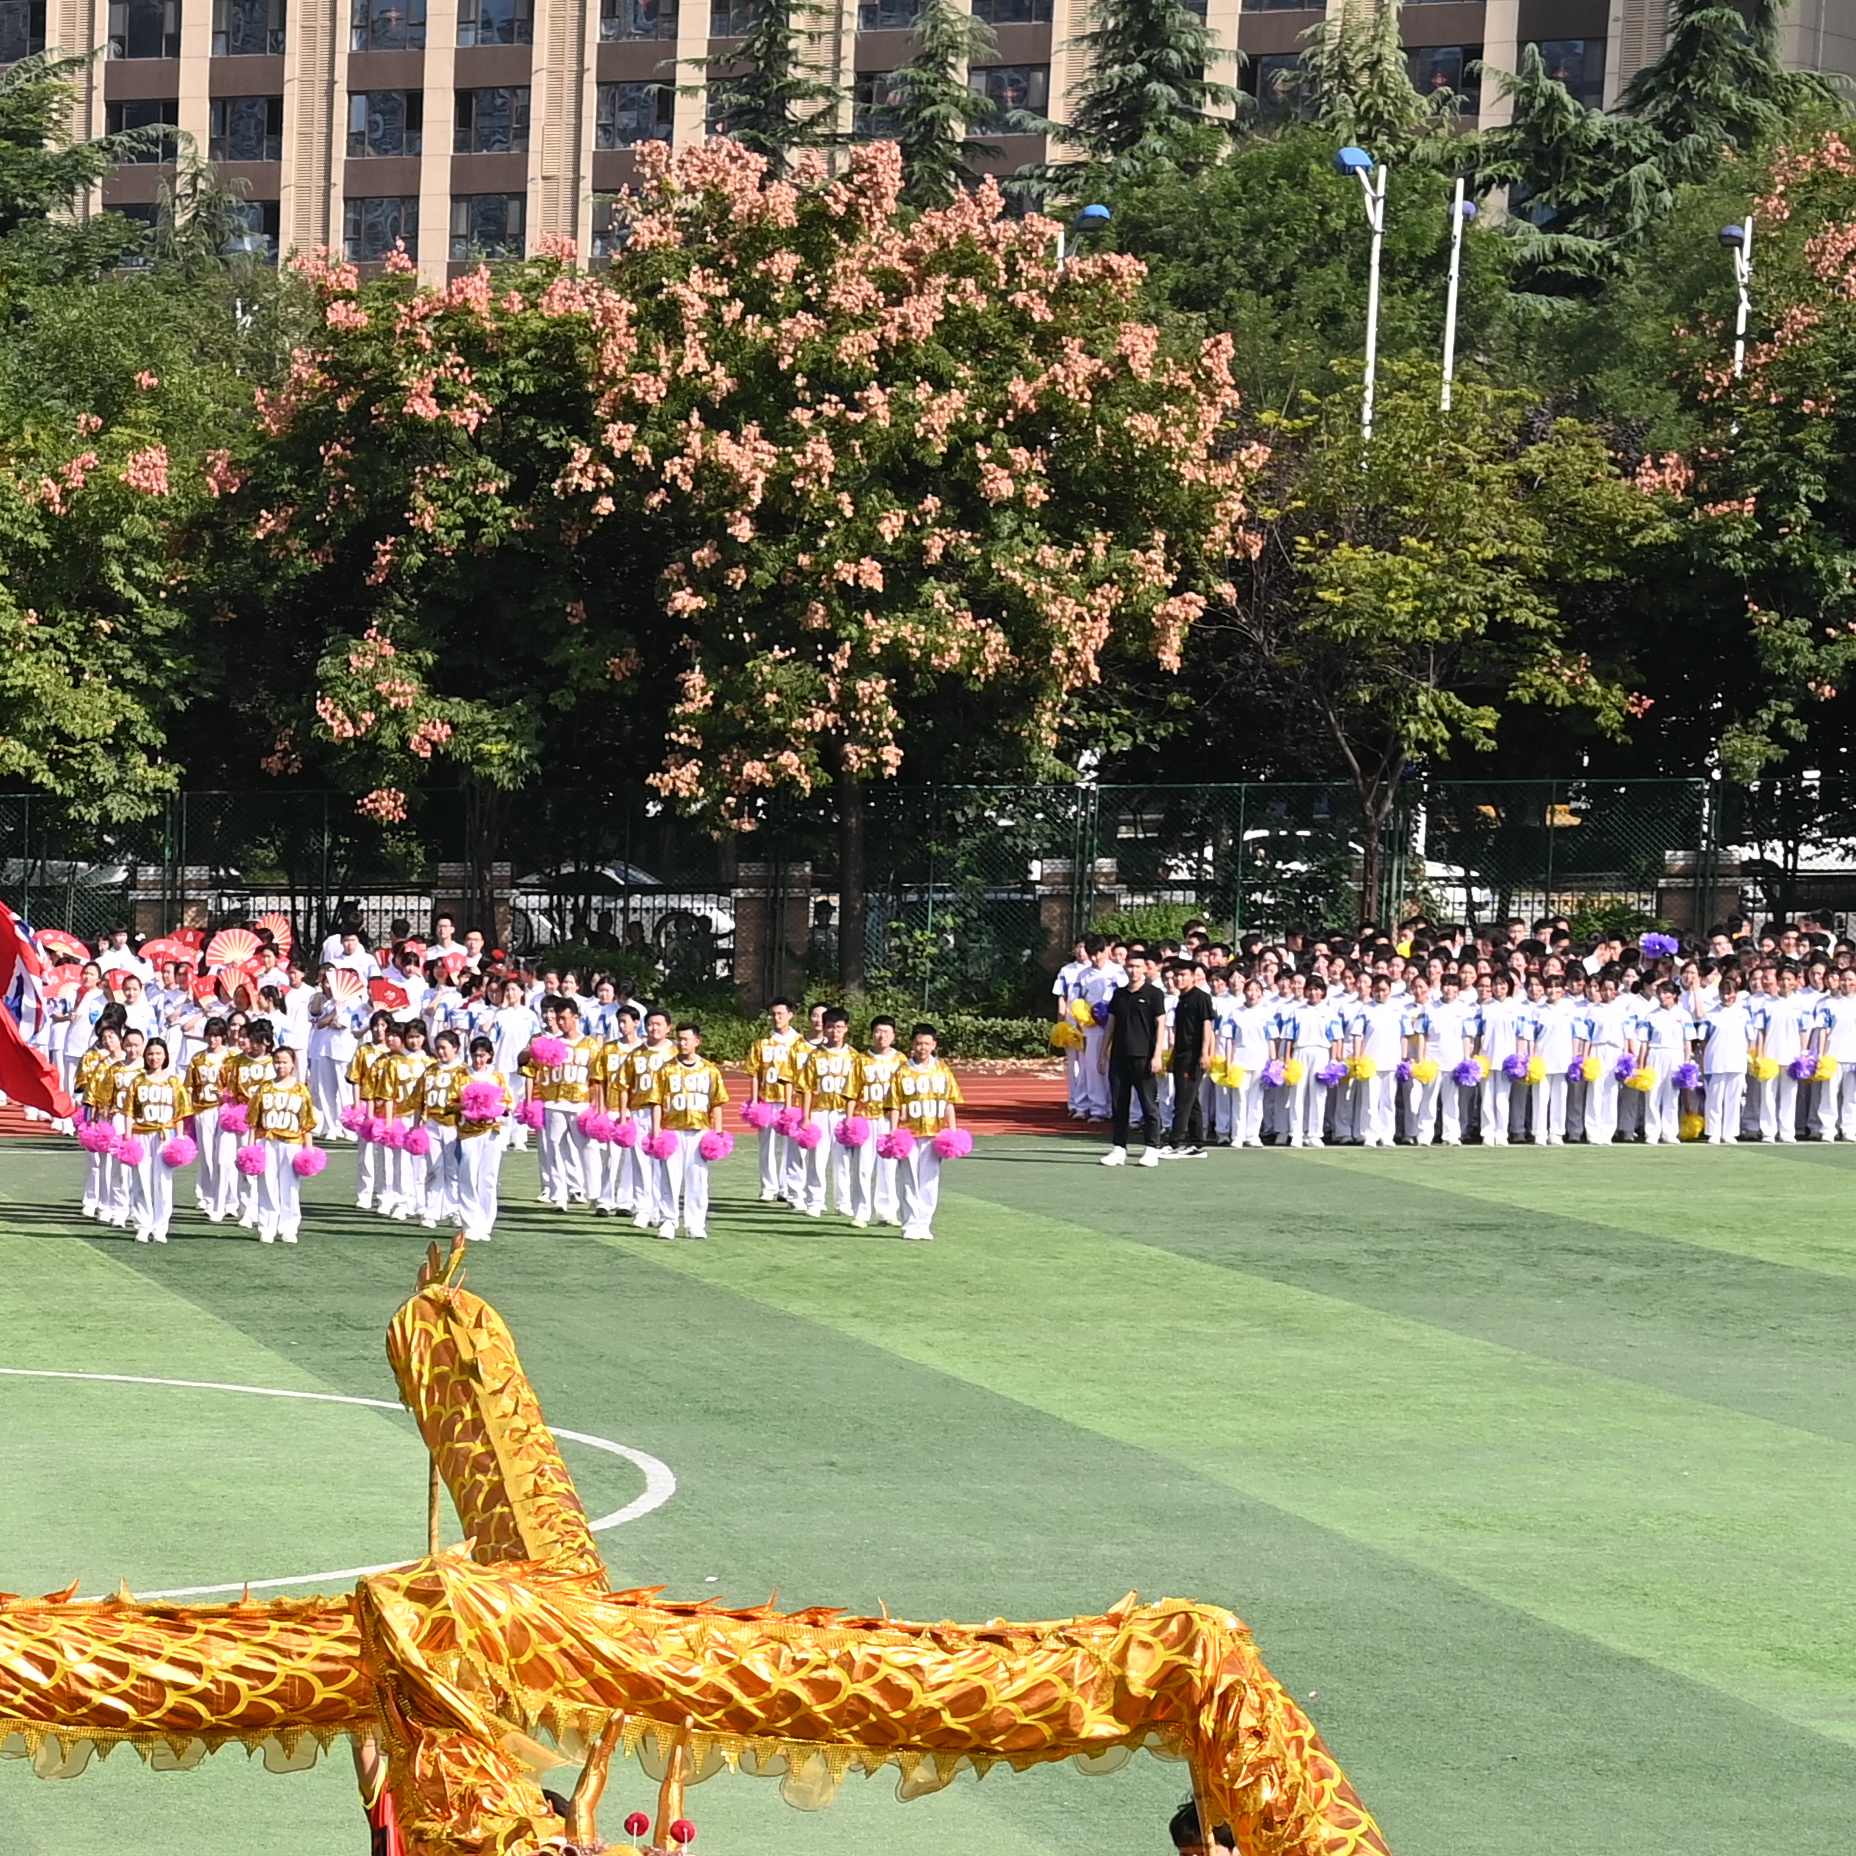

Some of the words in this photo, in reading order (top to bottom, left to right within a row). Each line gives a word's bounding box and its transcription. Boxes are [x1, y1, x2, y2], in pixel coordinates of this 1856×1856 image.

[425, 1072, 451, 1088] BO
[669, 1074, 710, 1093] BON
[902, 1075, 946, 1095] BON
[138, 1086, 173, 1103] BON
[262, 1092, 303, 1113] BON
